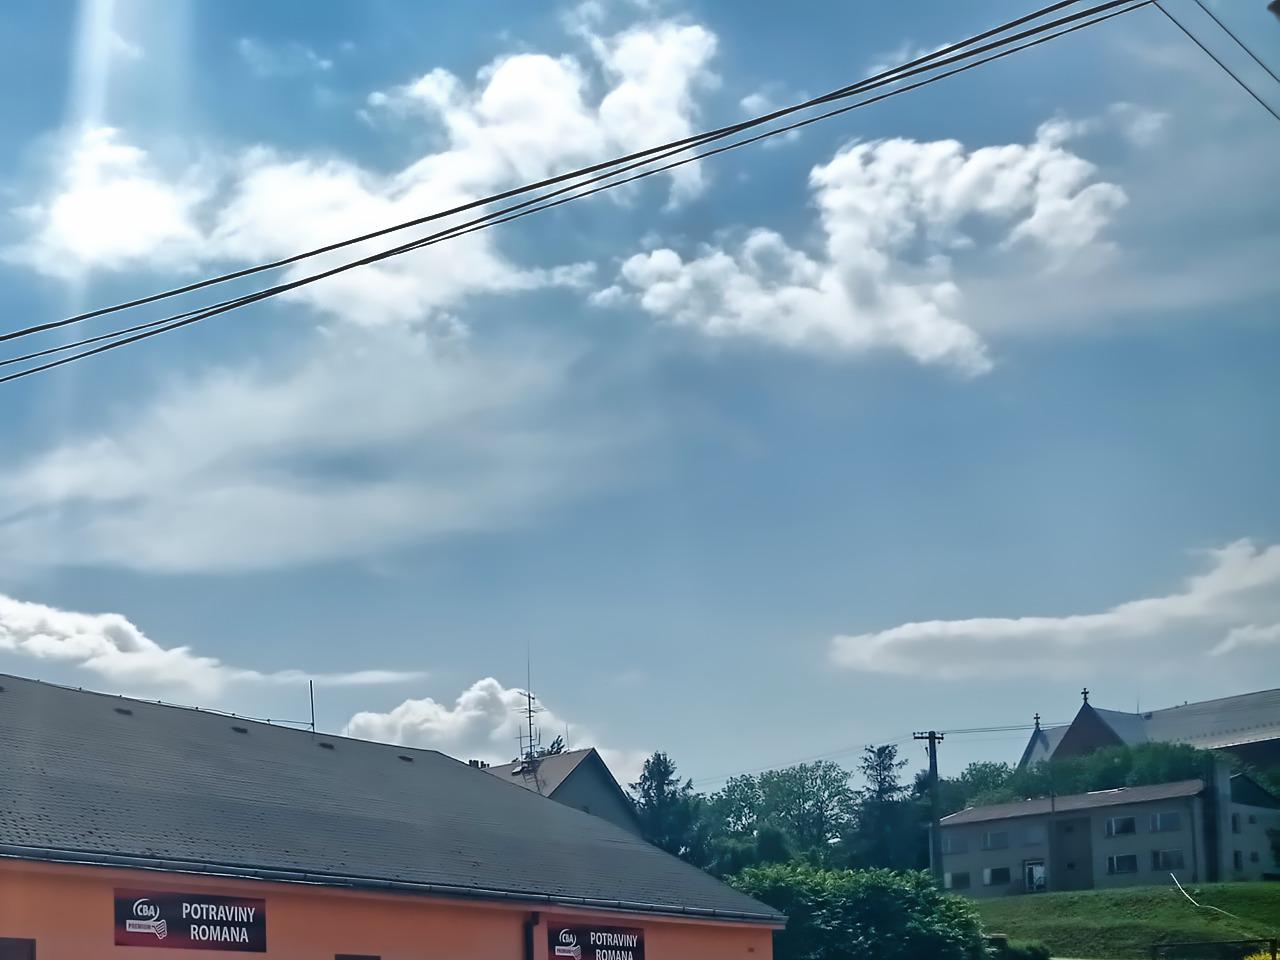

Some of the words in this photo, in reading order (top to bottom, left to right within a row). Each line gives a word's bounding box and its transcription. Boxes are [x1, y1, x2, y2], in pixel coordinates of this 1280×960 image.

[137, 904, 155, 916] CBA
[182, 903, 255, 922] POTRAVINY
[190, 925, 249, 942] ROMANA
[590, 932, 637, 947] POTRAVINY
